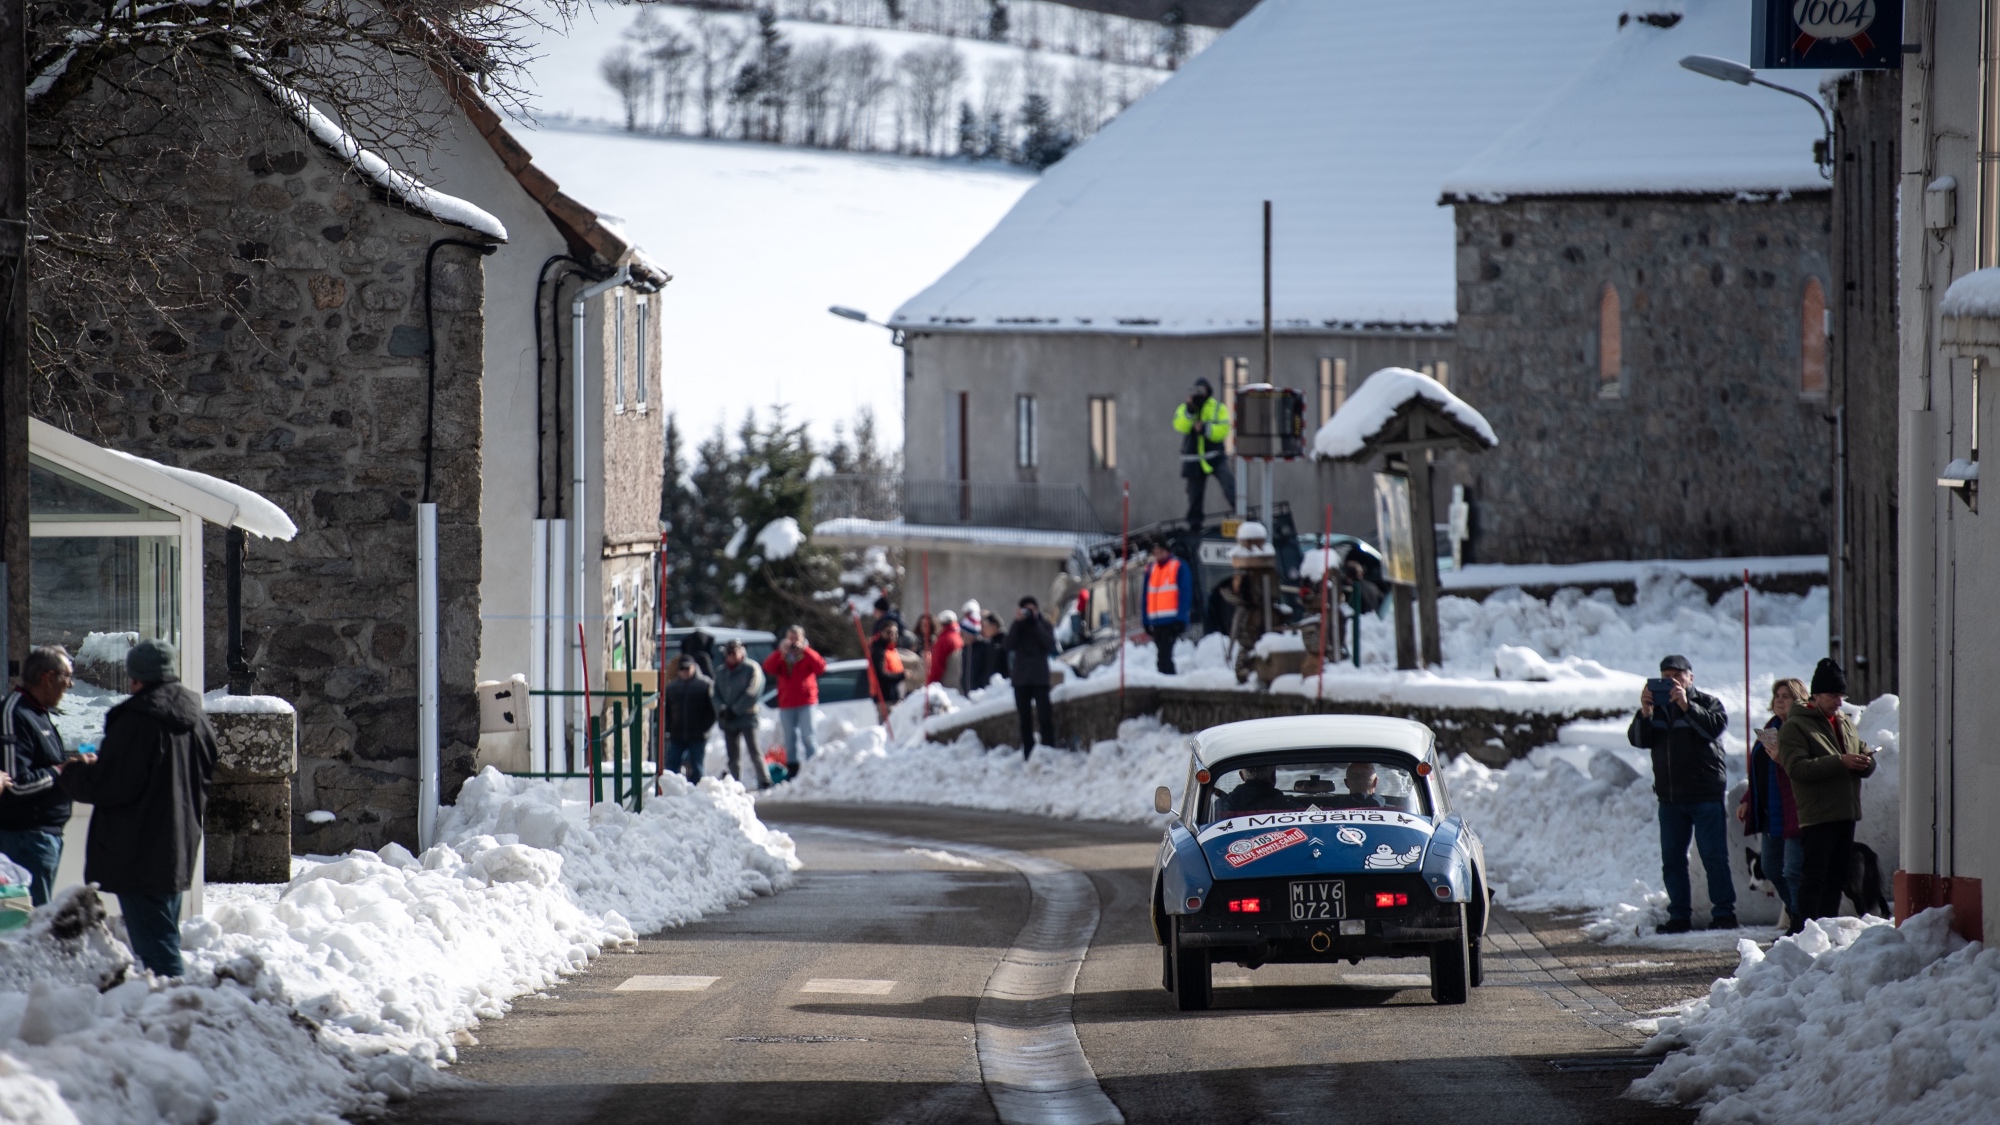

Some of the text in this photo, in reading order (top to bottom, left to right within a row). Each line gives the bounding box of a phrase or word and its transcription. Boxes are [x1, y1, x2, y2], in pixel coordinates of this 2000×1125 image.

[1798, 0, 1872, 28] 1664
[1248, 813, 1386, 826] Morgana
[1229, 851, 1256, 865] RALLYE
[1256, 831, 1303, 855] MONTE-CARLO
[1254, 835, 1272, 846] 105
[1294, 901, 1340, 919] 0721
